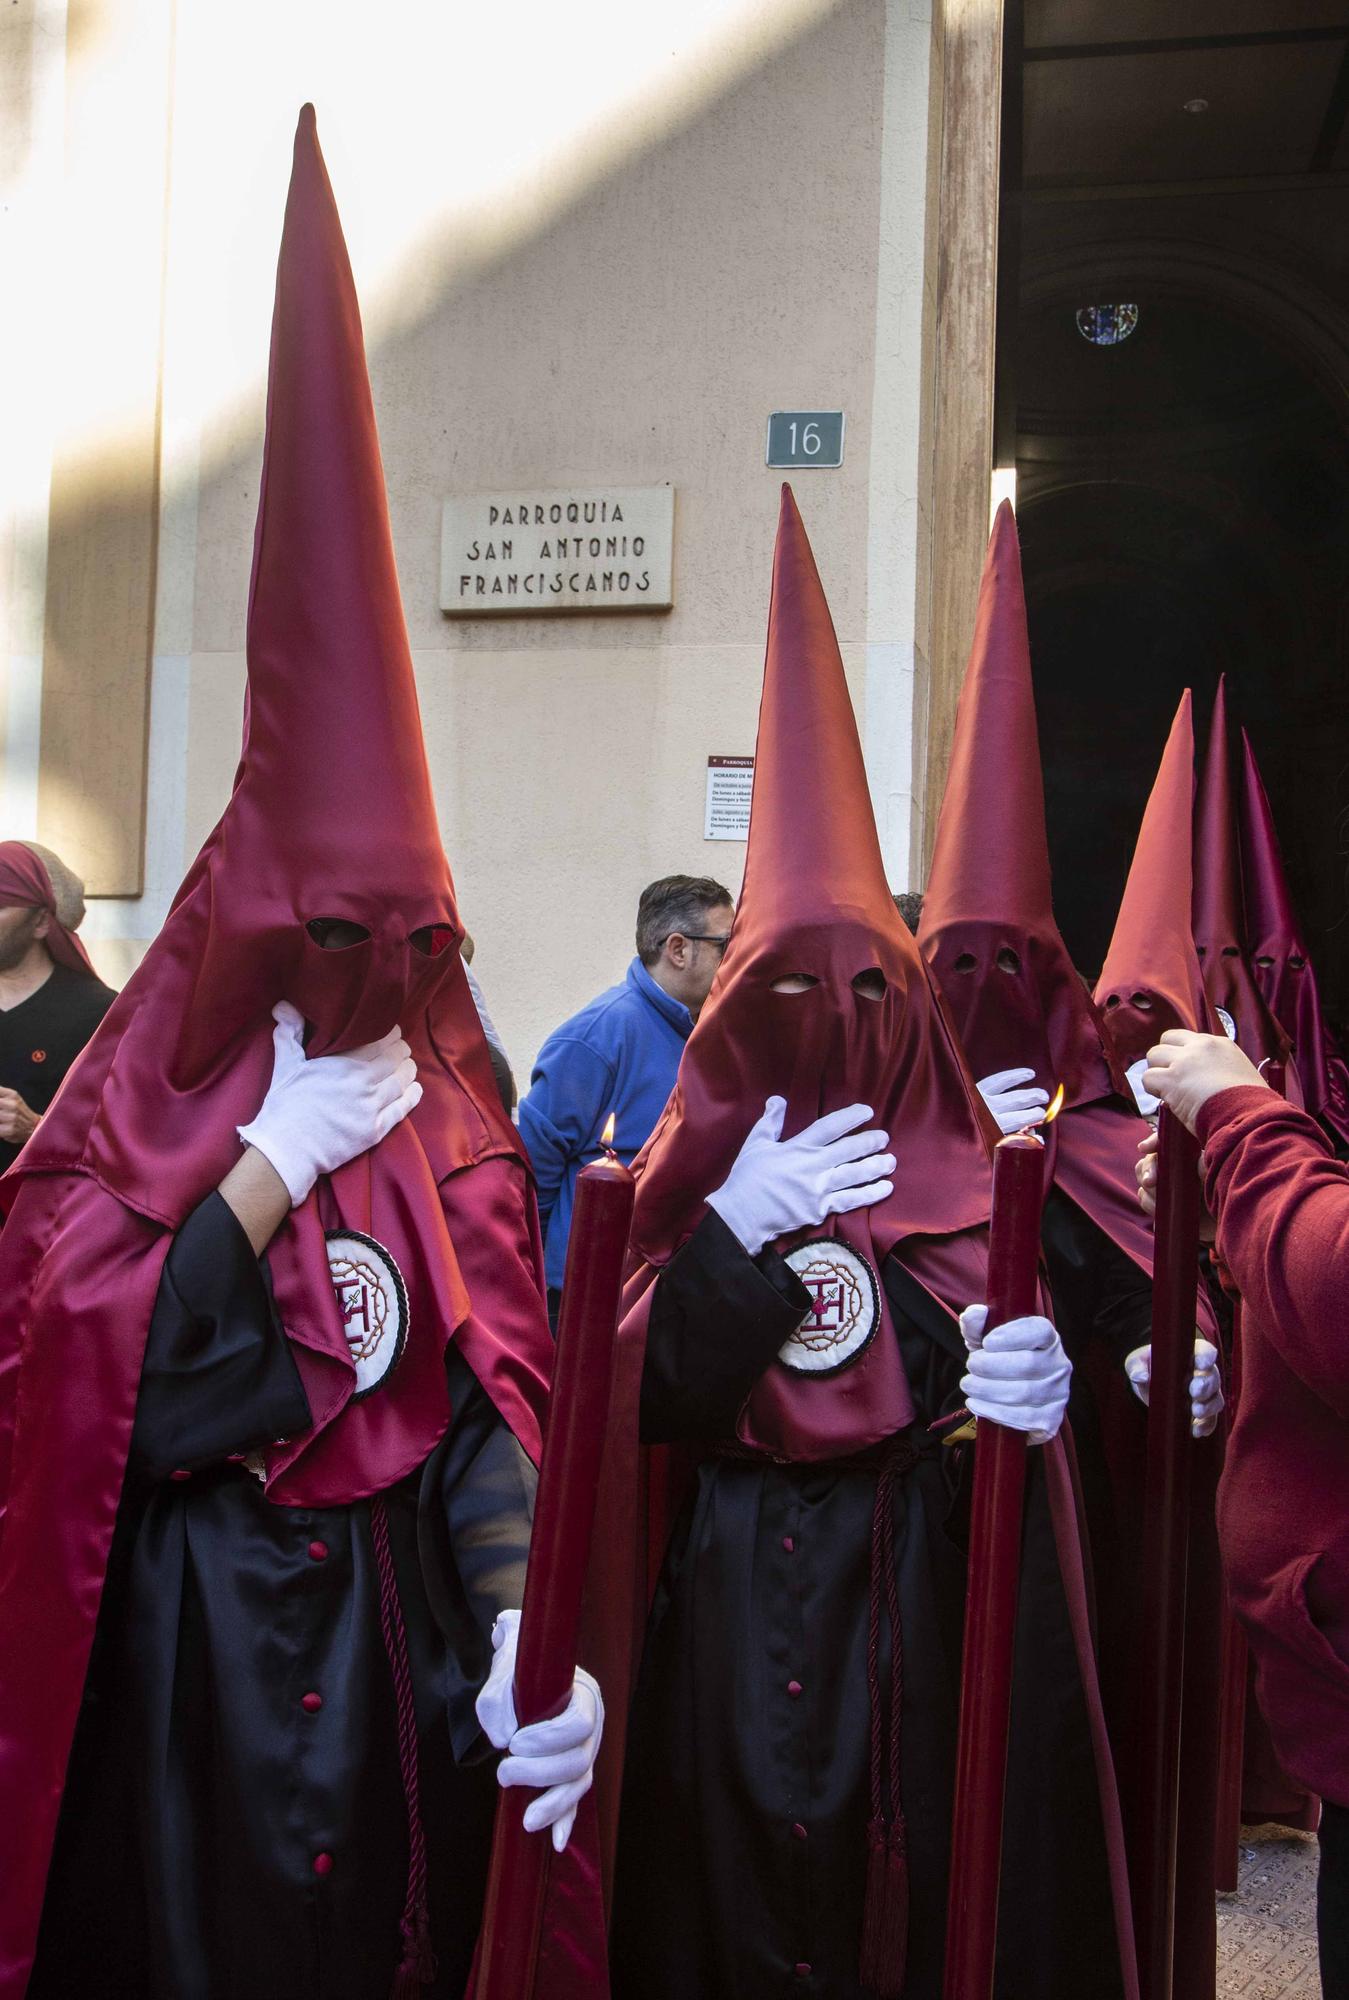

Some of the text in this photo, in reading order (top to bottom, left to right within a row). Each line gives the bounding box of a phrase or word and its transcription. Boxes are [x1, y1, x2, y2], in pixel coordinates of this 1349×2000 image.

[789, 422, 821, 455] 16
[489, 502, 624, 526] PARROQUIA
[467, 536, 645, 561] SAN ANTONIO
[460, 571, 651, 596] FRANCISCANOS
